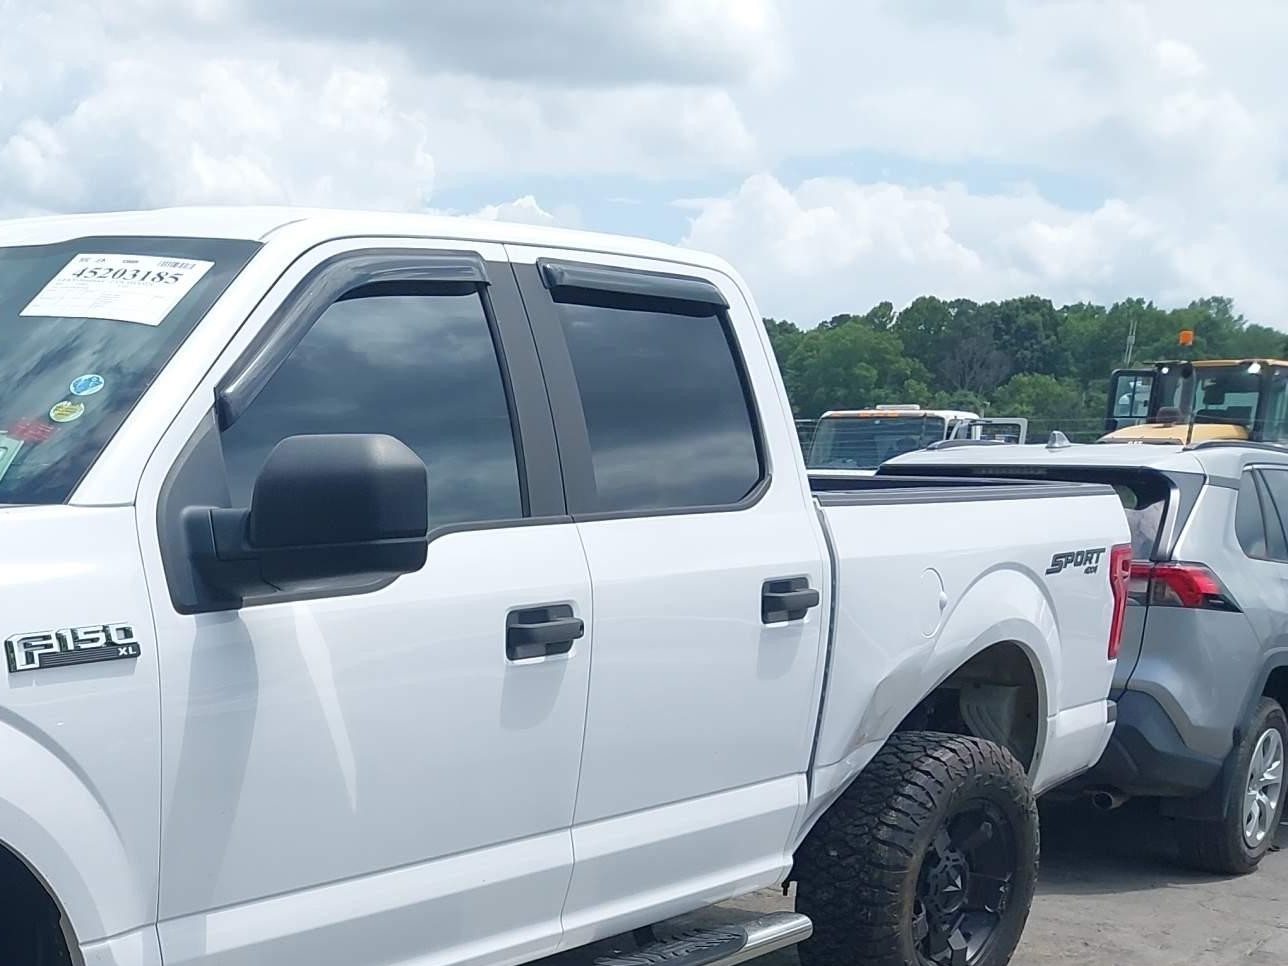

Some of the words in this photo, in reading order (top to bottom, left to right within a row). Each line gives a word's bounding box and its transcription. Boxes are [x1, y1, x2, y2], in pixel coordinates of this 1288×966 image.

[72, 266, 184, 285] 45203185
[1045, 547, 1106, 576] SPORT
[4, 622, 134, 672] F150
[118, 646, 137, 656] XL
